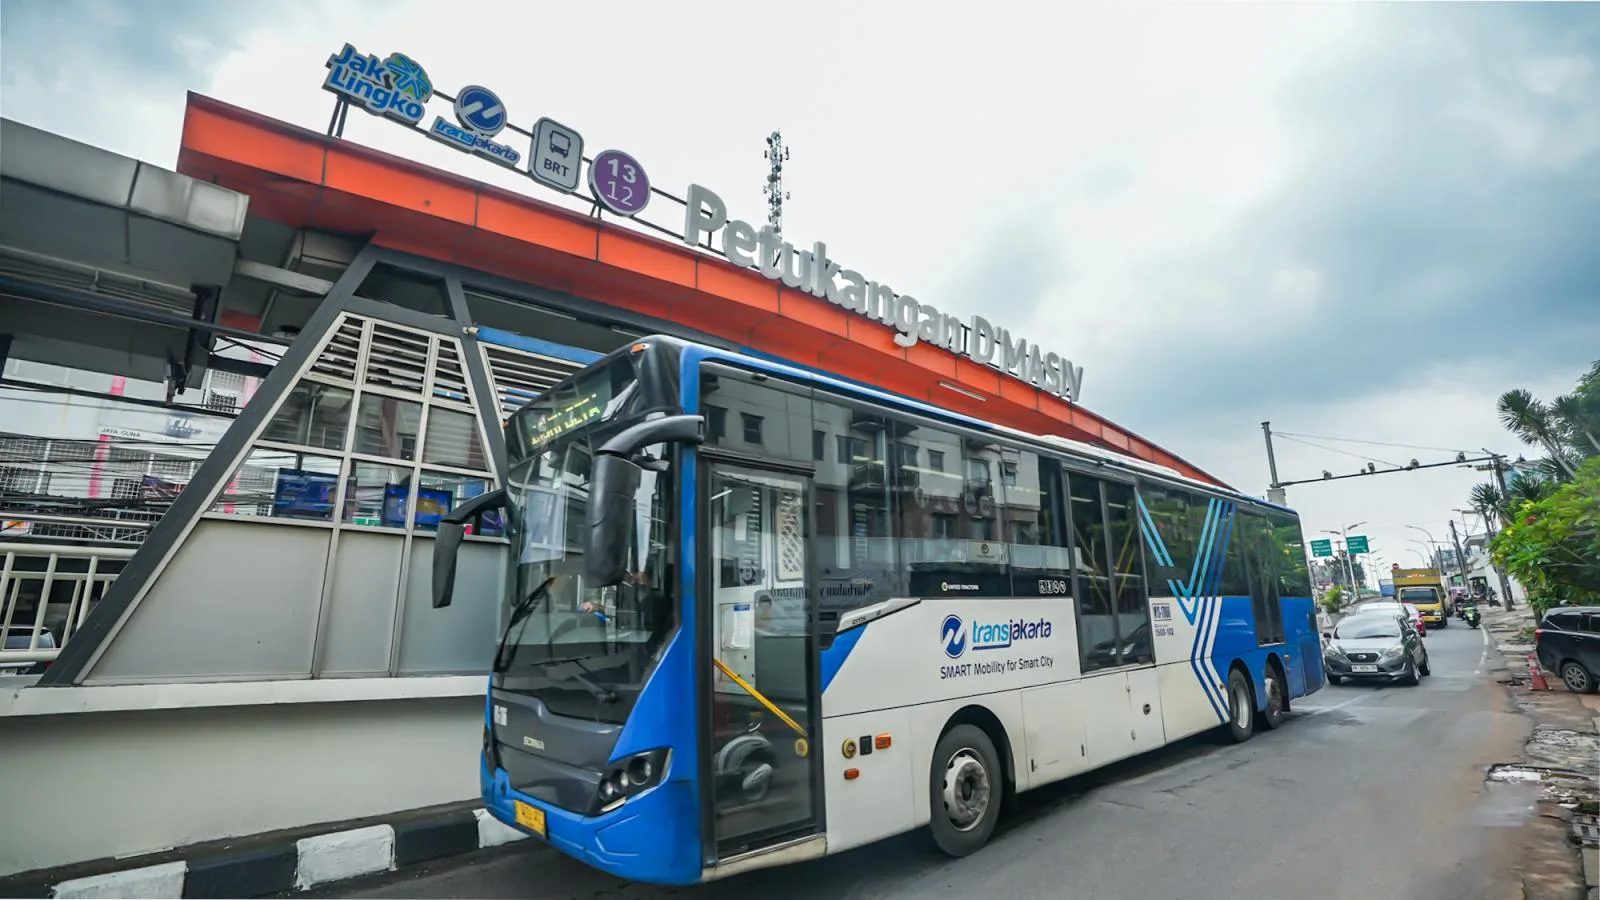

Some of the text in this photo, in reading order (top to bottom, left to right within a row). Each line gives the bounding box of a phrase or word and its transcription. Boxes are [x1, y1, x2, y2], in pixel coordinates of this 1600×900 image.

[334, 47, 385, 80] Jak
[330, 66, 423, 118] Lingko
[435, 118, 519, 163] transjakarta
[544, 159, 569, 178] BRT
[608, 158, 637, 184] 13
[607, 181, 633, 206] 12
[684, 183, 1083, 402] Petukangan D'MASIV
[102, 427, 119, 435] JAYA
[972, 618, 1052, 650] transjakarta
[940, 656, 1054, 680] SMART Mobility for Smart City
